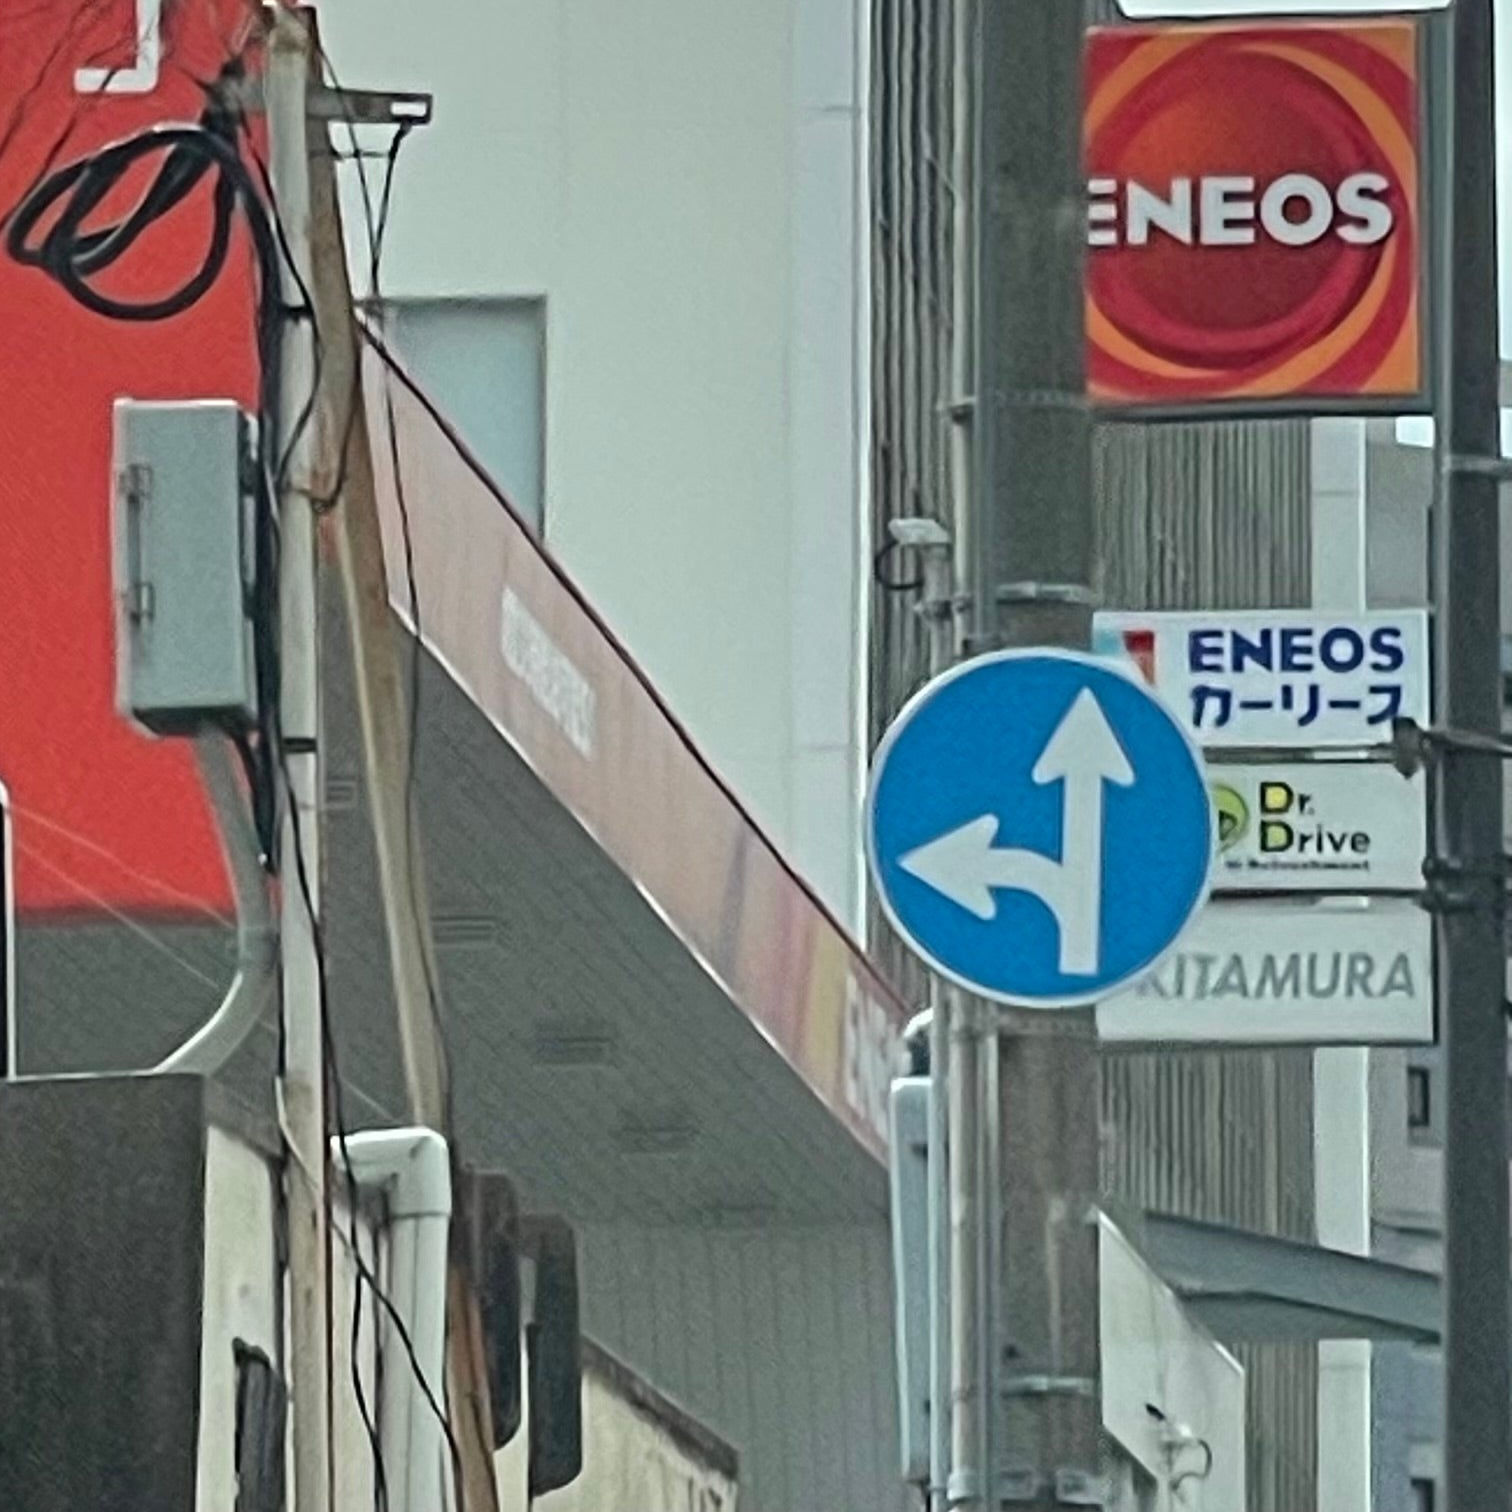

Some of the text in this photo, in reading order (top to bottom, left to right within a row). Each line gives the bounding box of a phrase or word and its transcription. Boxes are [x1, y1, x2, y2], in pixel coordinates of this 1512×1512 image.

[1188, 626, 1405, 674] ENEOS
[1259, 781, 1314, 816] Dr.
[1259, 819, 1372, 854] Drive
